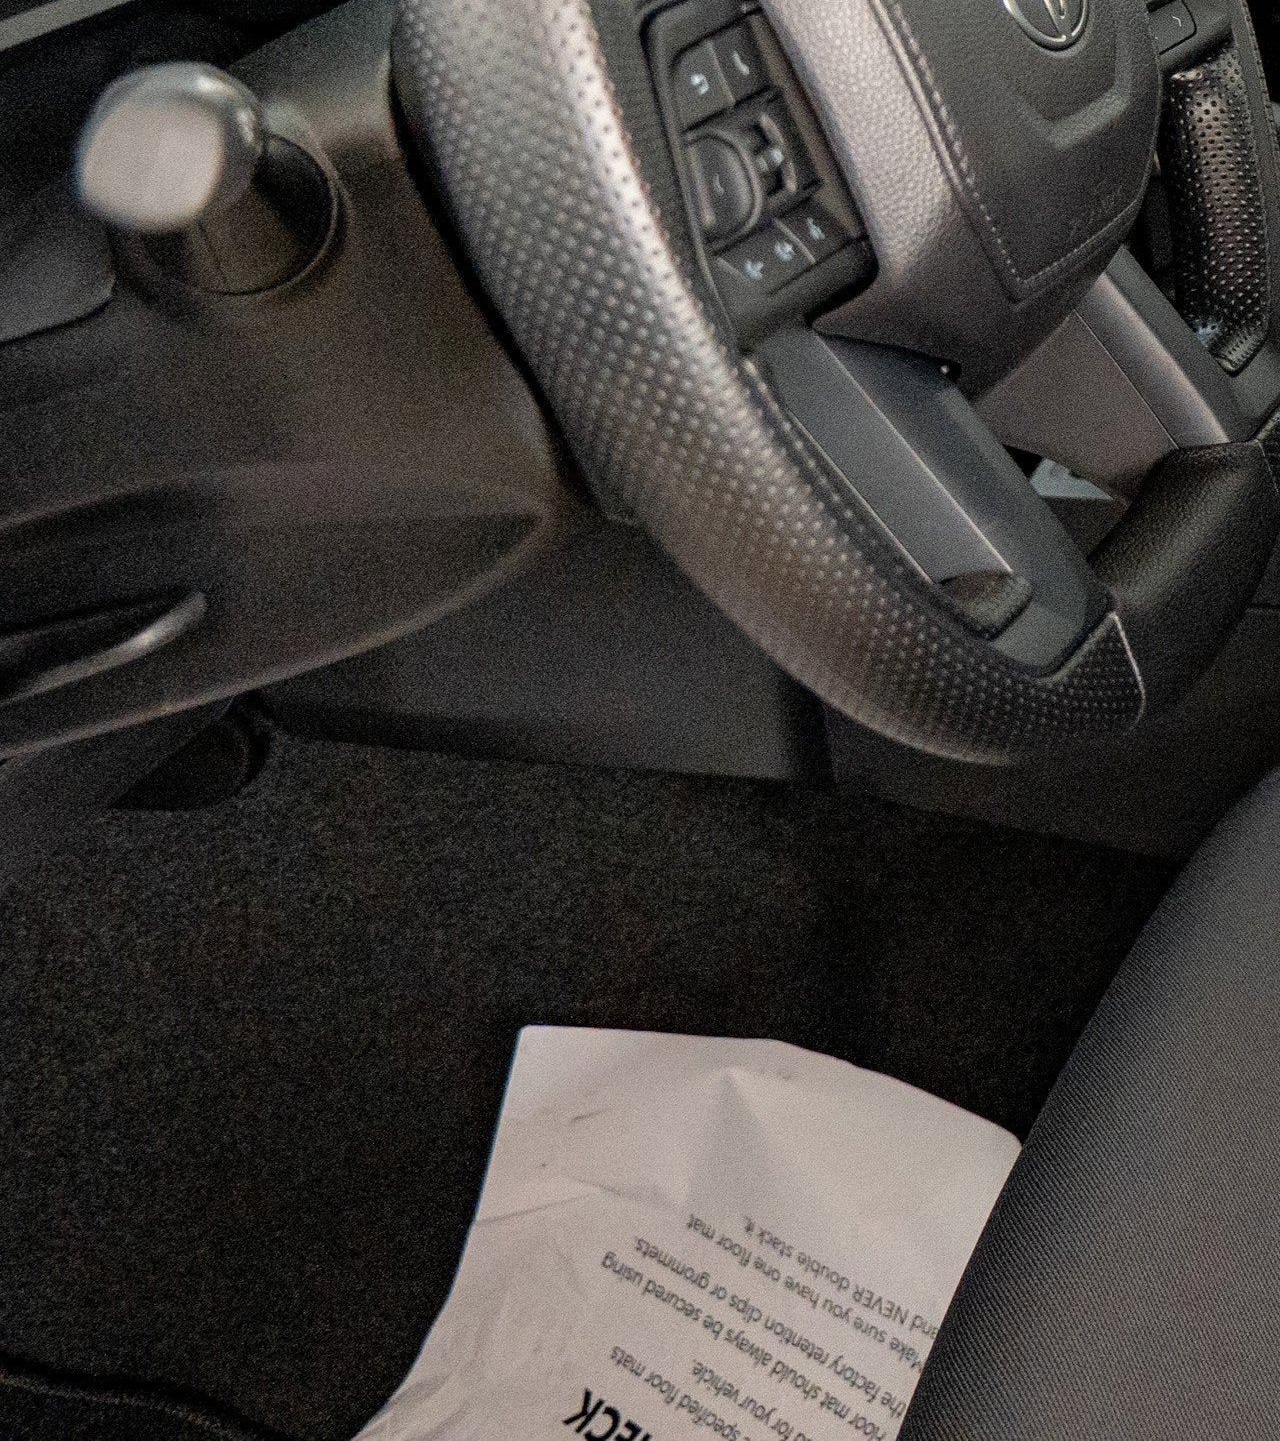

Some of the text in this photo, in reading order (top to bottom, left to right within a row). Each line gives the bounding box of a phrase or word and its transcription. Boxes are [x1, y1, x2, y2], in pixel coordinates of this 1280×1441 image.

[686, 1213, 716, 1240] mat
[758, 1227, 794, 1259] stack
[716, 1233, 753, 1268] floor
[601, 1250, 643, 1287] using
[753, 1257, 781, 1283] one
[796, 1251, 851, 1292] double
[642, 1279, 703, 1322] secured
[784, 1275, 821, 1310] have
[851, 1283, 909, 1326] NEVER
[634, 1236, 906, 1419] the factory retention clips or grommets.
[703, 1315, 724, 1340] be
[822, 1298, 854, 1324] you
[726, 1328, 773, 1368] always
[852, 1317, 888, 1344] sure
[611, 1346, 739, 1441] specified floor mats
[691, 1358, 739, 1403] vehicle.
[769, 1361, 822, 1399] should
[738, 1396, 777, 1426] your
[820, 1392, 850, 1420] mat
